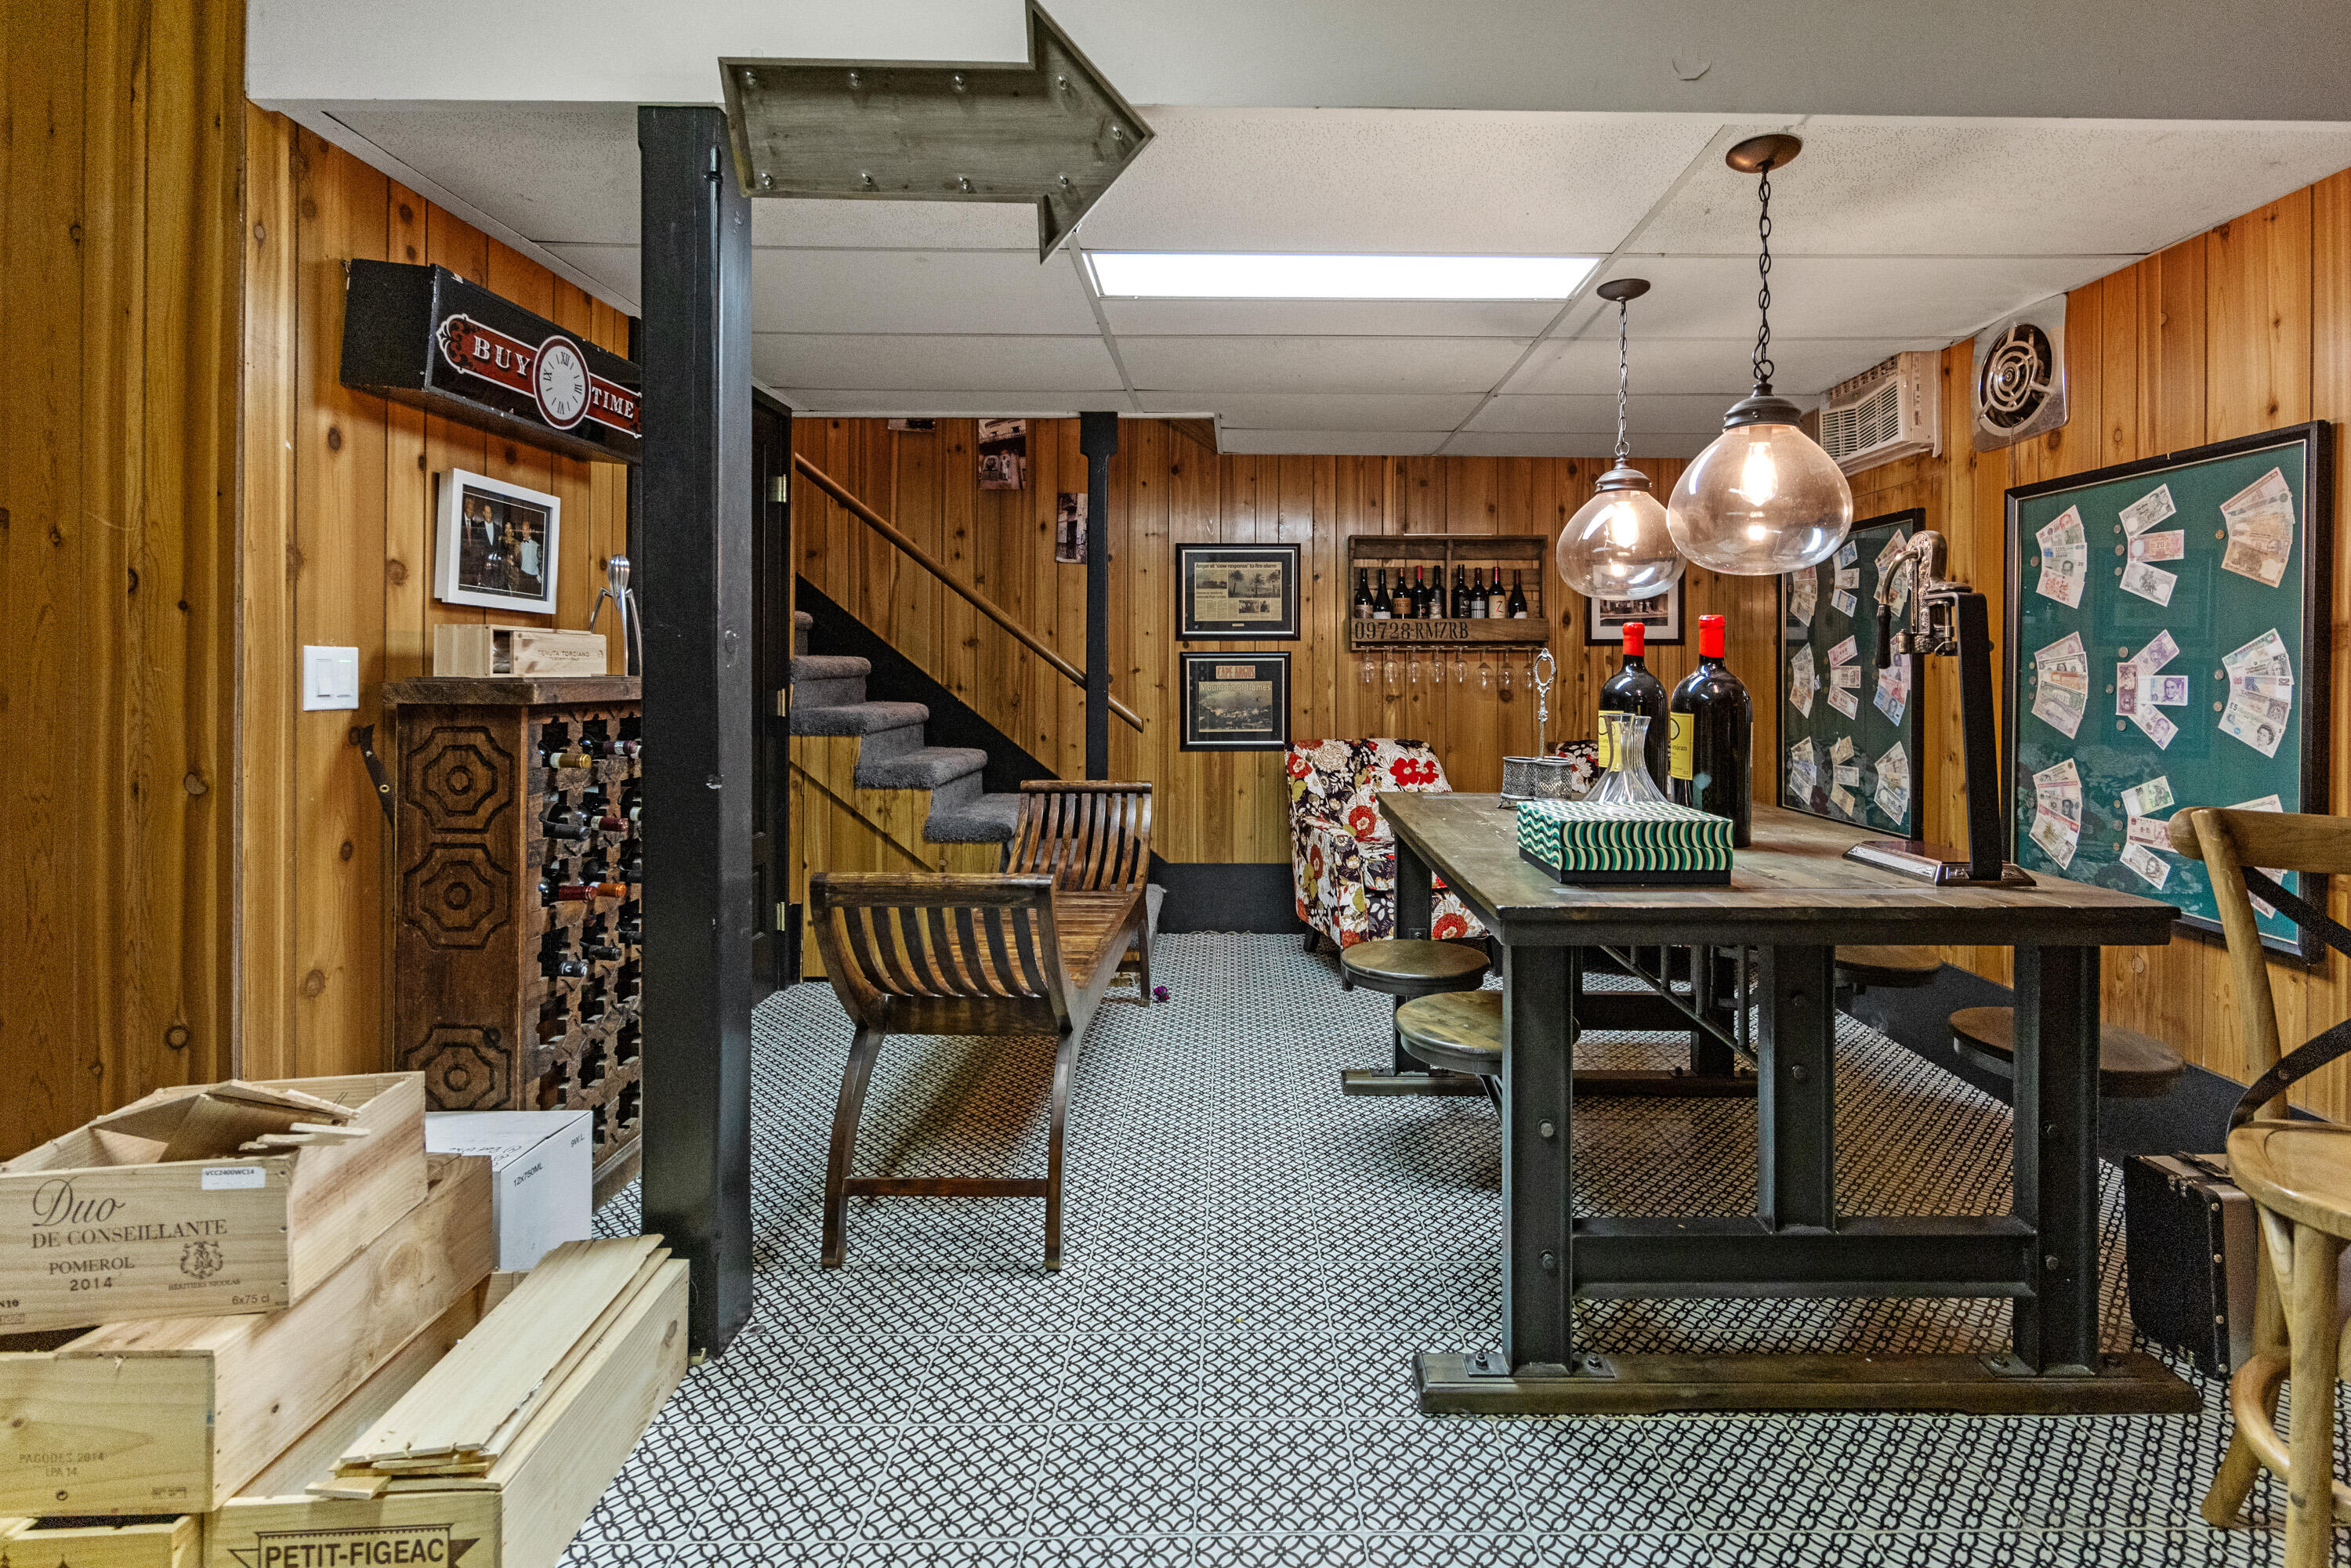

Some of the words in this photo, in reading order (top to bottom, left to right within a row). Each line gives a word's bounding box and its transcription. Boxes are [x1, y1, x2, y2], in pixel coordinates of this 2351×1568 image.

[472, 335, 531, 376] BUY
[592, 386, 634, 418] TIME
[1354, 621, 1469, 640] 09728-RMZRB
[1217, 666, 1233, 679] CAPE
[1234, 666, 1255, 679] ARGUS
[1200, 683, 1236, 691] Mountain
[1244, 683, 1271, 691] flames
[2229, 702, 2238, 711] £5
[32, 1175, 125, 1227] Duo
[31, 1231, 60, 1249] DE
[67, 1219, 227, 1246] CONSEILLANTE
[49, 1256, 136, 1275] POMEROL
[70, 1276, 113, 1291] 2014
[231, 1295, 258, 1305] 6x75
[260, 1293, 270, 1303] cl
[78, 1451, 105, 1463] 2014
[265, 1537, 445, 1568] PETIT-FIGEAC
